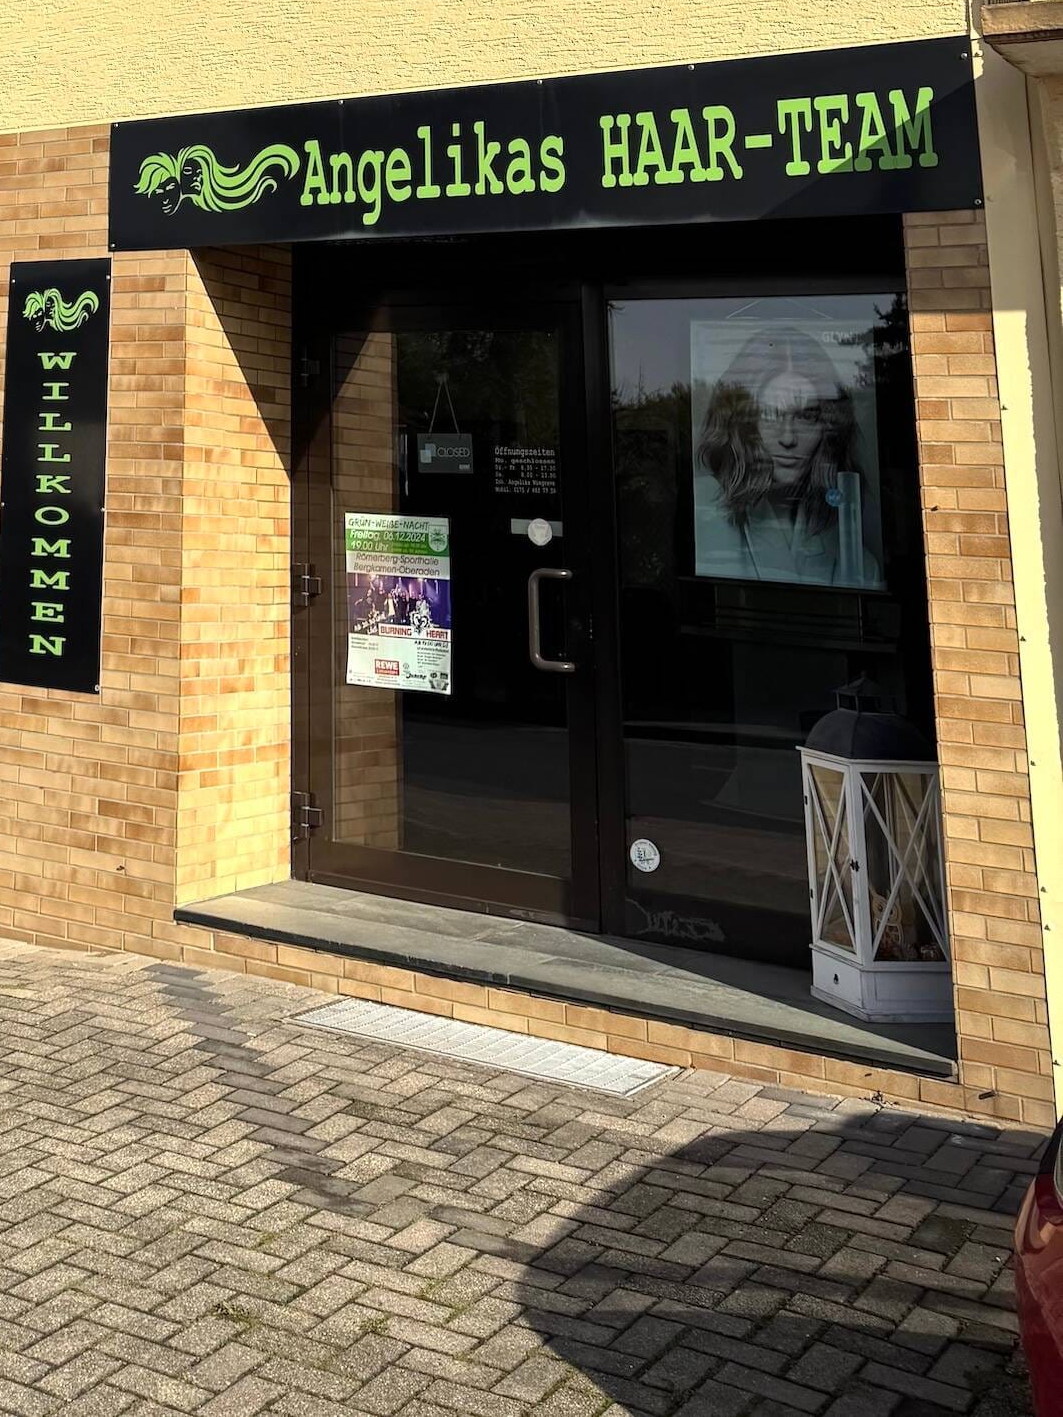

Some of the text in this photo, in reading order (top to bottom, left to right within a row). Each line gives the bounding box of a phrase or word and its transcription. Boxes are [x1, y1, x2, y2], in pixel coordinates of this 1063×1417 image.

[300, 87, 938, 225] Angelikas HAAR-TEAM
[437, 446, 471, 458] CLOSED
[495, 446, 556, 457] Öffnungszeiten
[29, 352, 77, 656] WILLKOMMEN
[383, 531, 426, 542] 06.12.2024
[351, 541, 373, 550] 19.00
[355, 552, 439, 566] Römerberg-Sporthalle
[353, 562, 440, 576] Bergkamen-Oberaden
[380, 625, 449, 640] BURNING HEART
[375, 660, 399, 671] REWE
